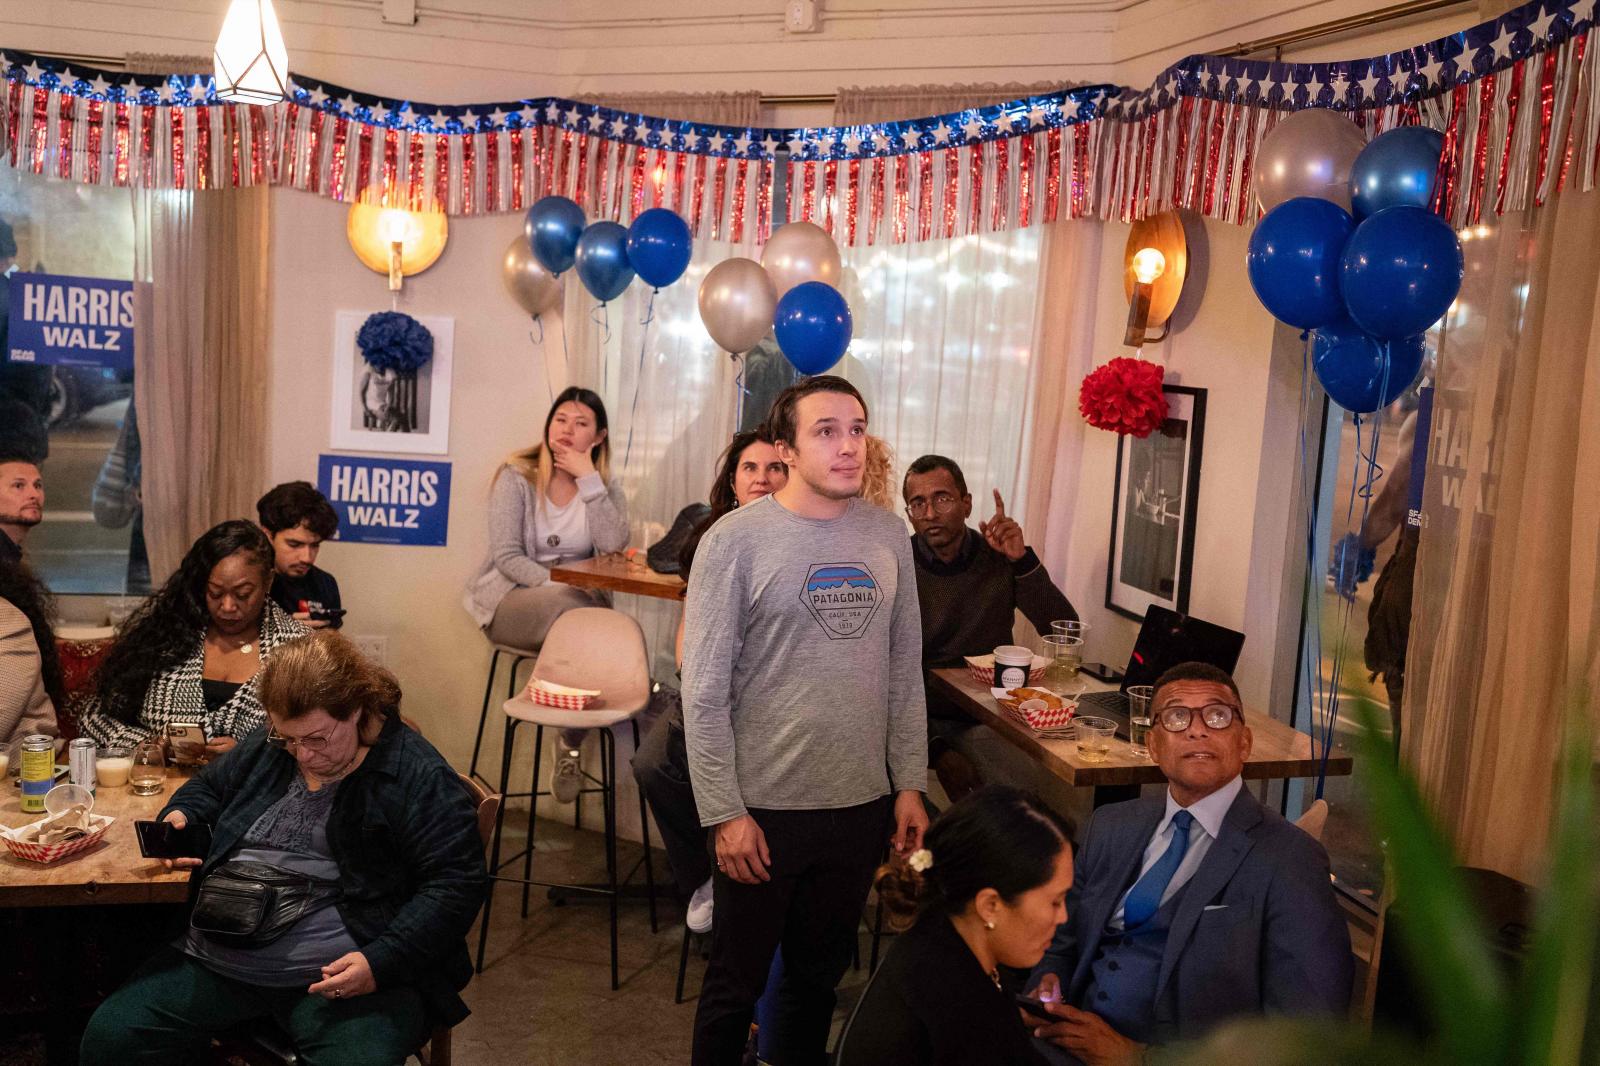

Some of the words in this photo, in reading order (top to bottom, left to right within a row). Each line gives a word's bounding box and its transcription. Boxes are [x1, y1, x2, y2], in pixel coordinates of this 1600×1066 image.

[23, 283, 135, 328] HARRIS
[42, 326, 121, 351] WALZ
[330, 464, 439, 507] HARRIS
[347, 505, 420, 529] WALZ
[813, 592, 874, 604] PATAGONIA
